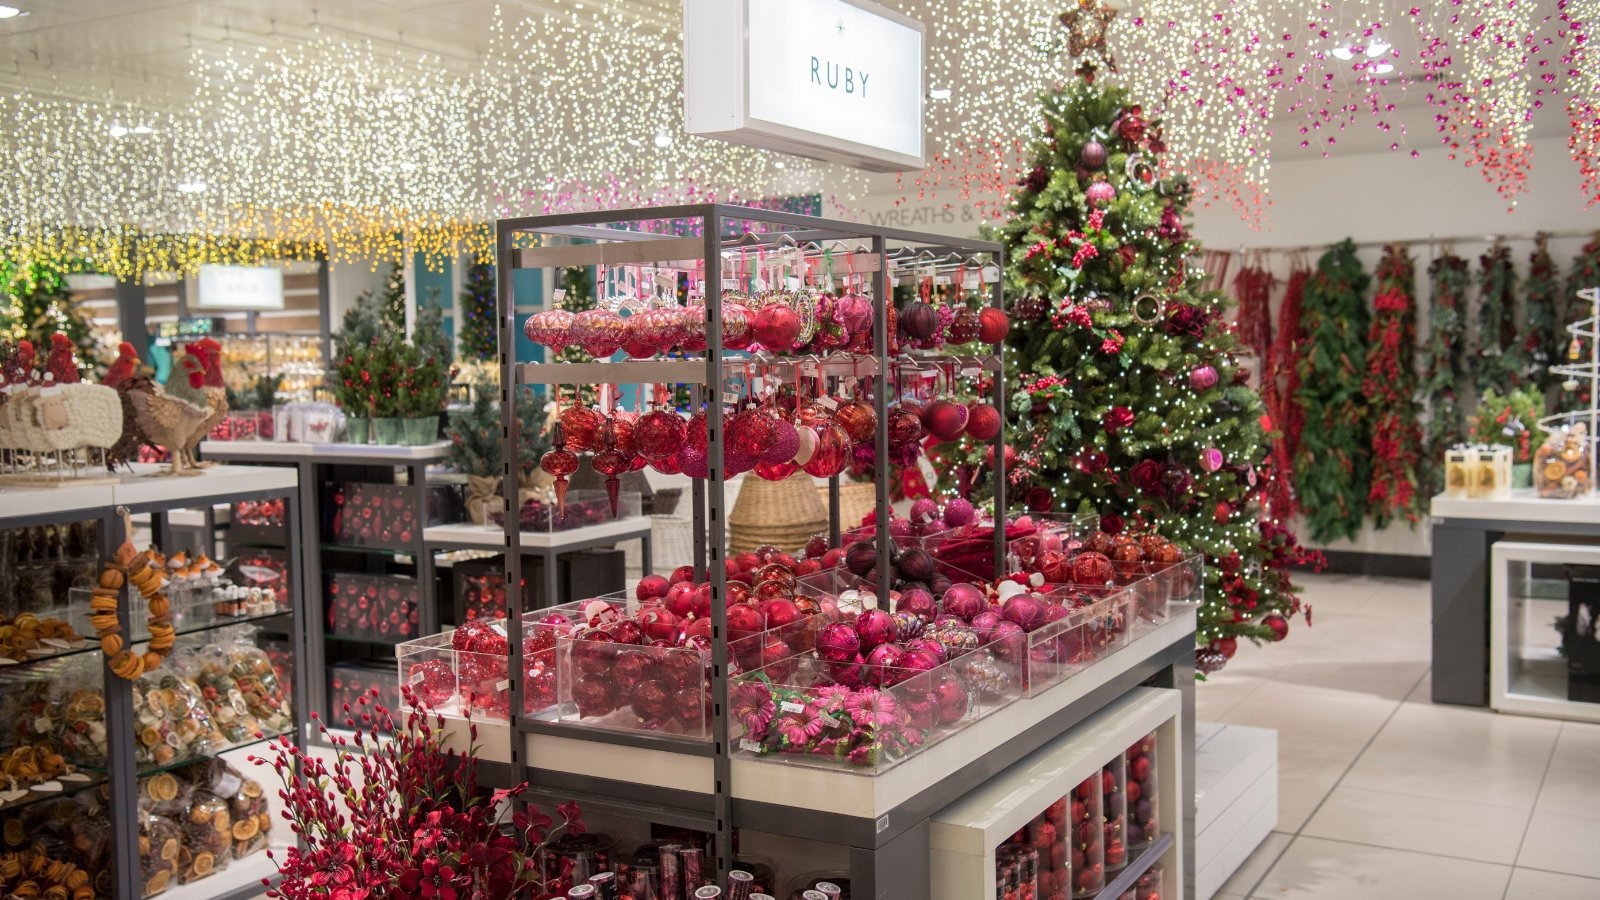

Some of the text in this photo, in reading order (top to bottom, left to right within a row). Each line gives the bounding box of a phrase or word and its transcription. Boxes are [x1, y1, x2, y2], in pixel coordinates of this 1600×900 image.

[810, 56, 869, 98] RUBY
[868, 206, 955, 227] WREATHS
[961, 204, 974, 222] &
